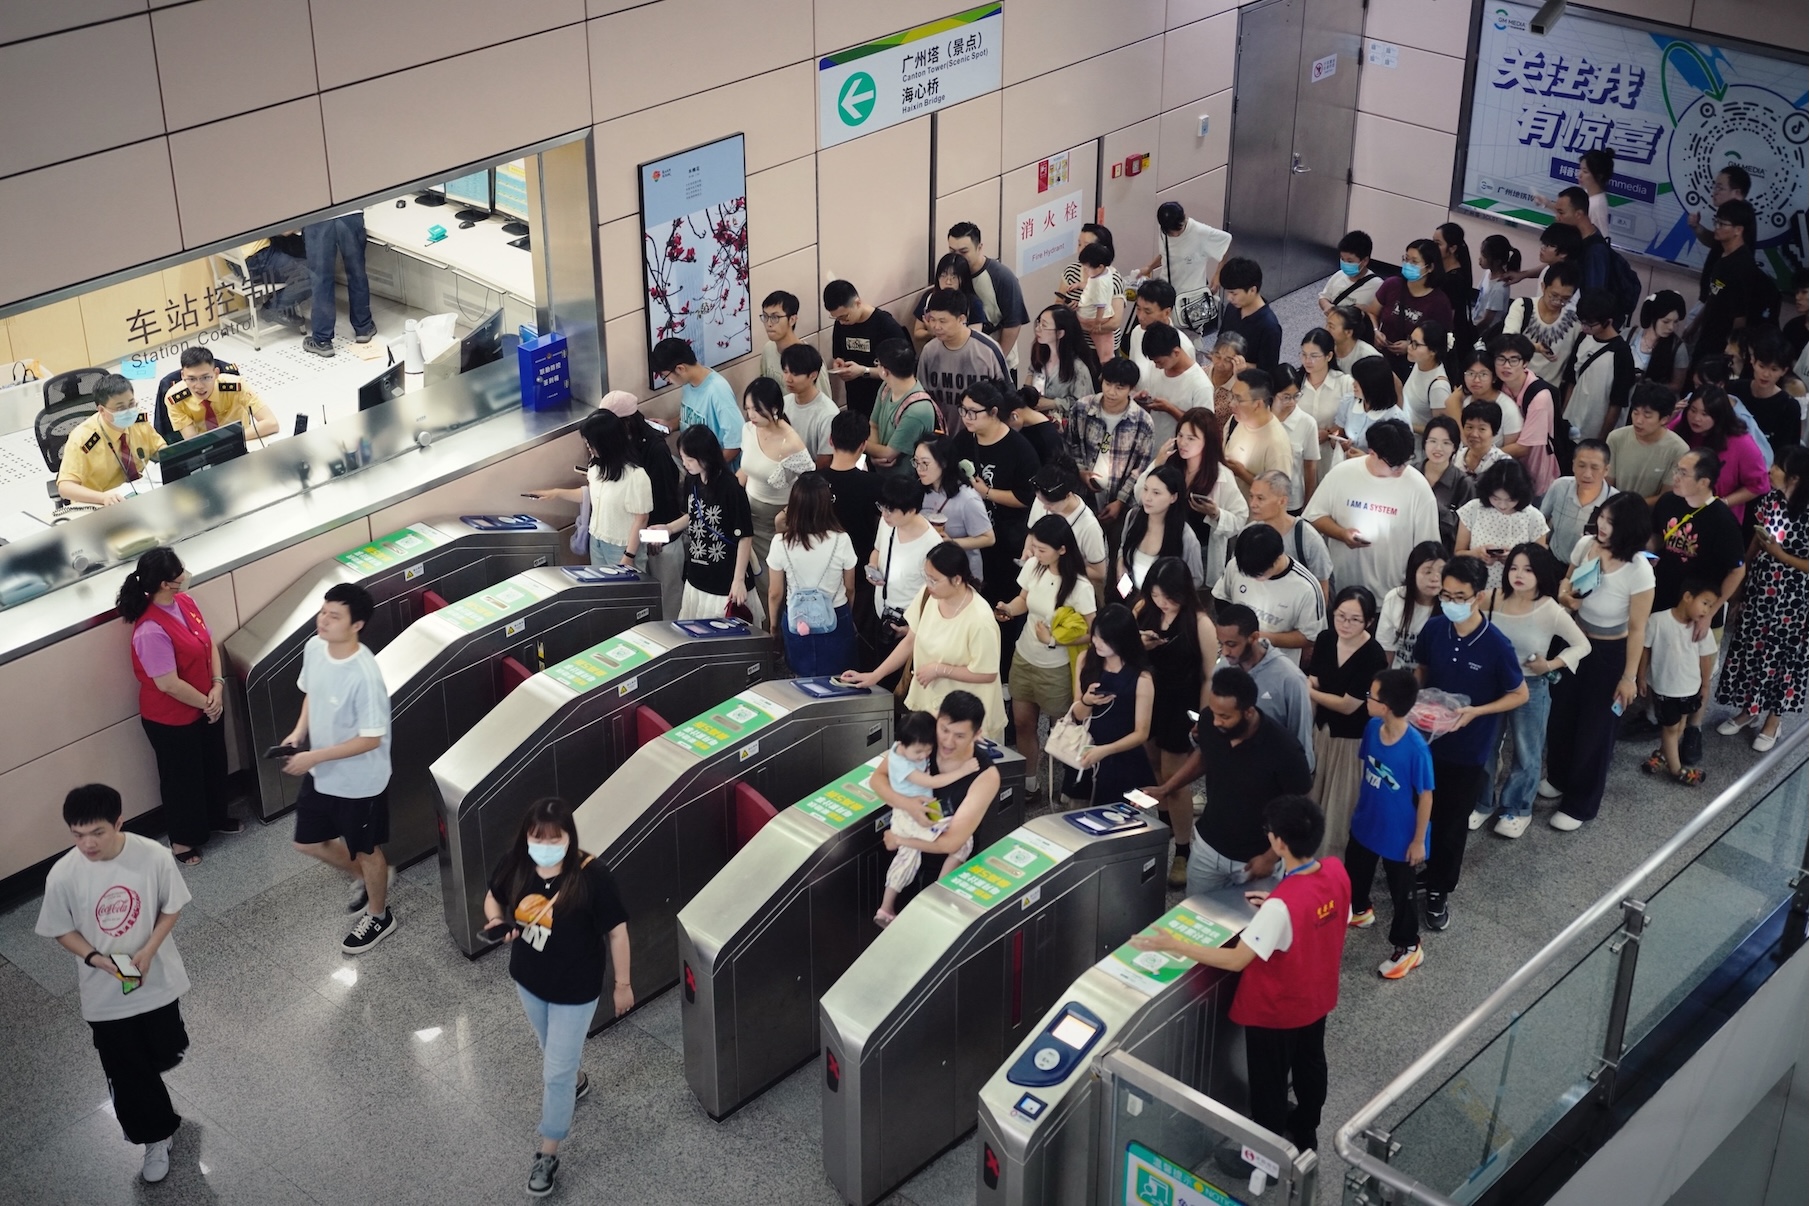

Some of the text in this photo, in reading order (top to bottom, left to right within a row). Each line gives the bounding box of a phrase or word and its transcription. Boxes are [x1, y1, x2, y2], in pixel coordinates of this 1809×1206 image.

[1508, 19, 1526, 27] MEDIA
[902, 32, 983, 73] 广州塔（景点）
[902, 48, 989, 82] Canton Tower(Scenic Spot)
[902, 77, 939, 104] 海心桥
[1492, 48, 1646, 110] 关注我
[902, 94, 946, 114] Haixin Bridge
[1516, 102, 1664, 165] 有惊喜
[1021, 201, 1078, 241] 消火栓
[1032, 243, 1065, 261] Fire Hydrant
[131, 315, 256, 368] Station Control
[1350, 500, 1361, 508] AM
[1369, 503, 1398, 516] SYSTEM
[1205, 1188, 1240, 1206] NOTIC
